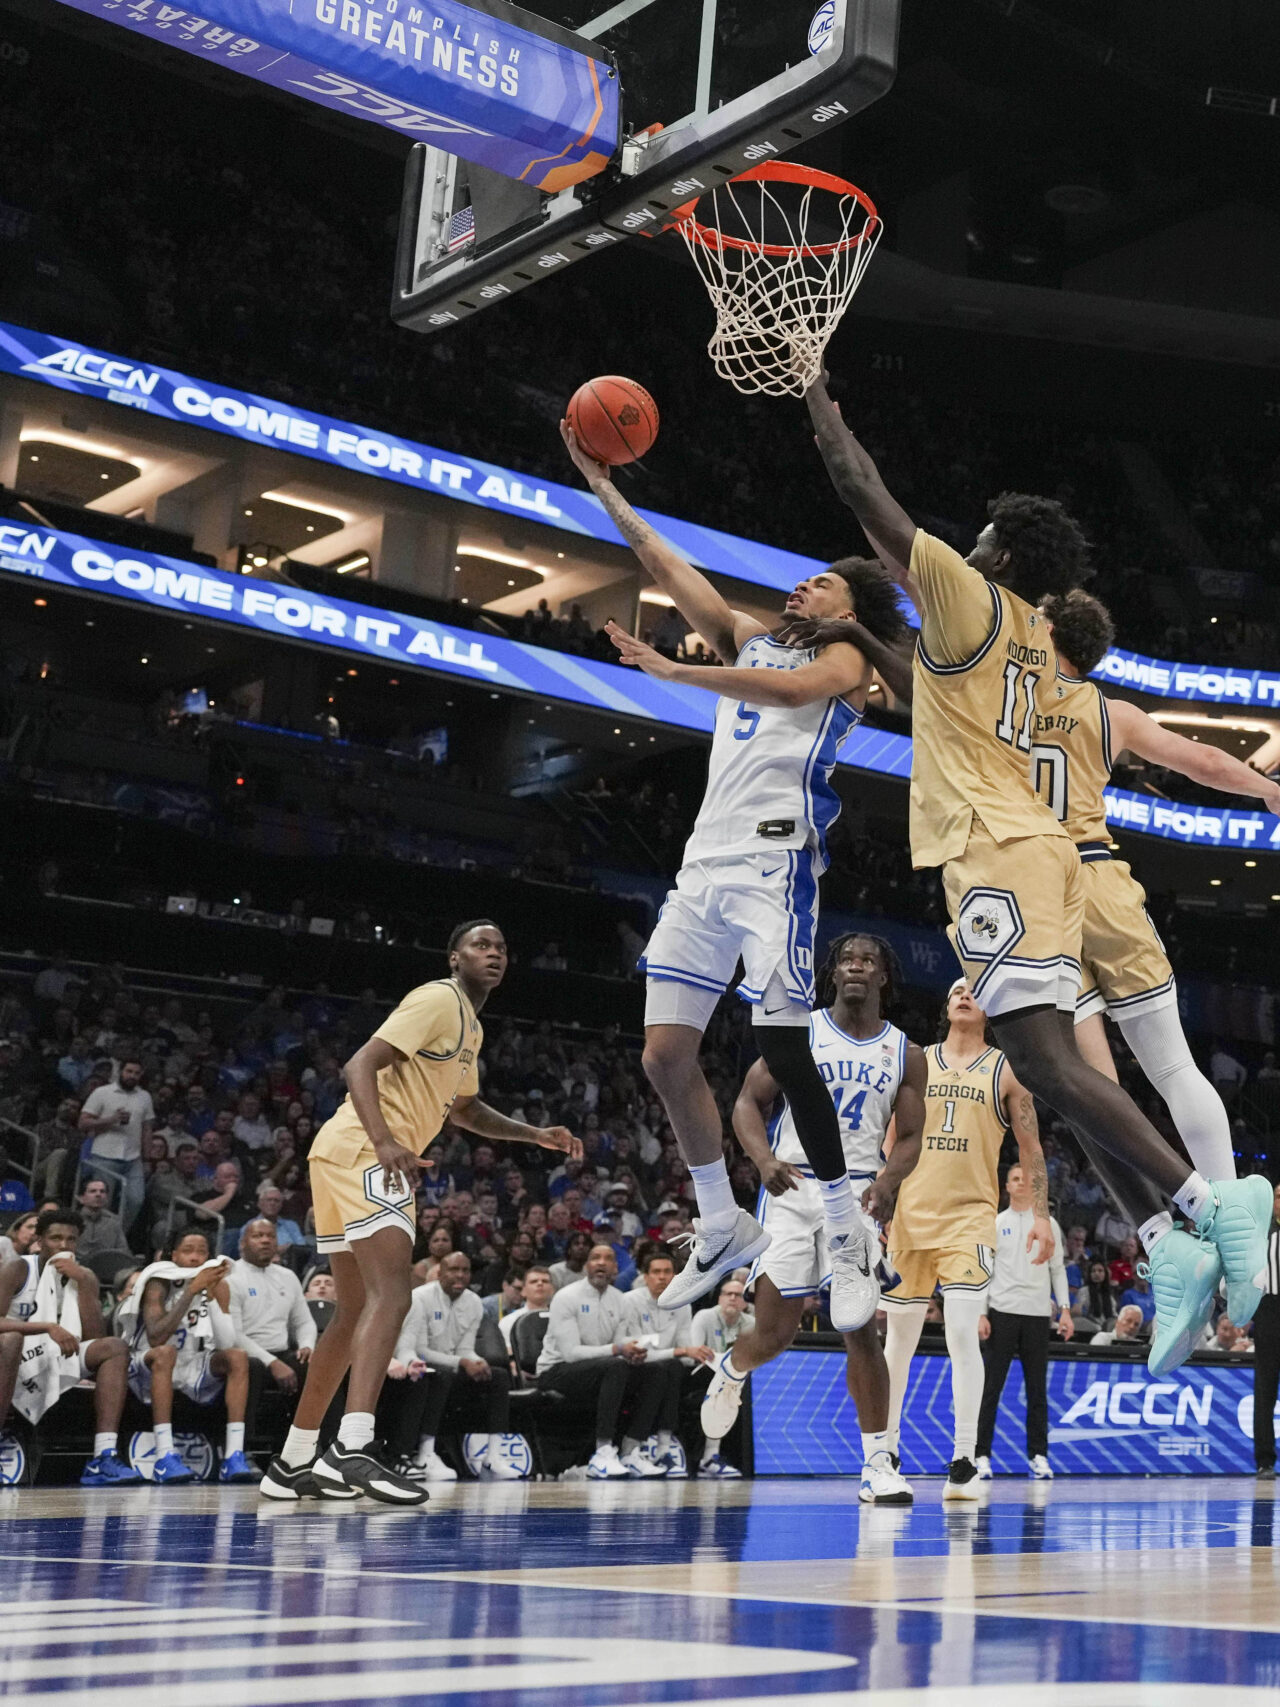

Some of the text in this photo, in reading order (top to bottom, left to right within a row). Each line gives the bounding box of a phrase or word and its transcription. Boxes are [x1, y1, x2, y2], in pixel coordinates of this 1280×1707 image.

[114, 0, 260, 53] GREAT
[812, 16, 835, 38] AC
[316, 0, 519, 97] GREATNESS
[287, 73, 473, 135] ACC
[812, 101, 849, 122] ally
[743, 140, 779, 160] ally
[671, 176, 706, 196] ally
[623, 207, 657, 227] ally
[585, 230, 617, 246] ally
[538, 251, 570, 268] ally
[480, 282, 511, 298] ally
[428, 310, 459, 326] ally
[37, 348, 561, 518] ACCN COME FOR IT ALL
[0, 525, 498, 672] CN COME FOR IT ALL
[1095, 655, 1170, 689] OME
[1175, 671, 1251, 698] FOR
[734, 699, 761, 741] 5
[996, 659, 1040, 754] 11
[1034, 714, 1079, 735] ERRY
[1031, 743, 1068, 822] 0
[1104, 794, 1150, 827] ME
[1153, 806, 1221, 838] FOR
[1228, 818, 1264, 841] IT
[816, 1060, 893, 1095] DUKE
[832, 1087, 868, 1131] 14
[925, 1084, 986, 1105] EORGIA
[941, 1100, 956, 1133] 1
[926, 1136, 969, 1152] TECH
[1059, 1381, 1213, 1426] ACCN
[1158, 1436, 1210, 1456] ESPN
